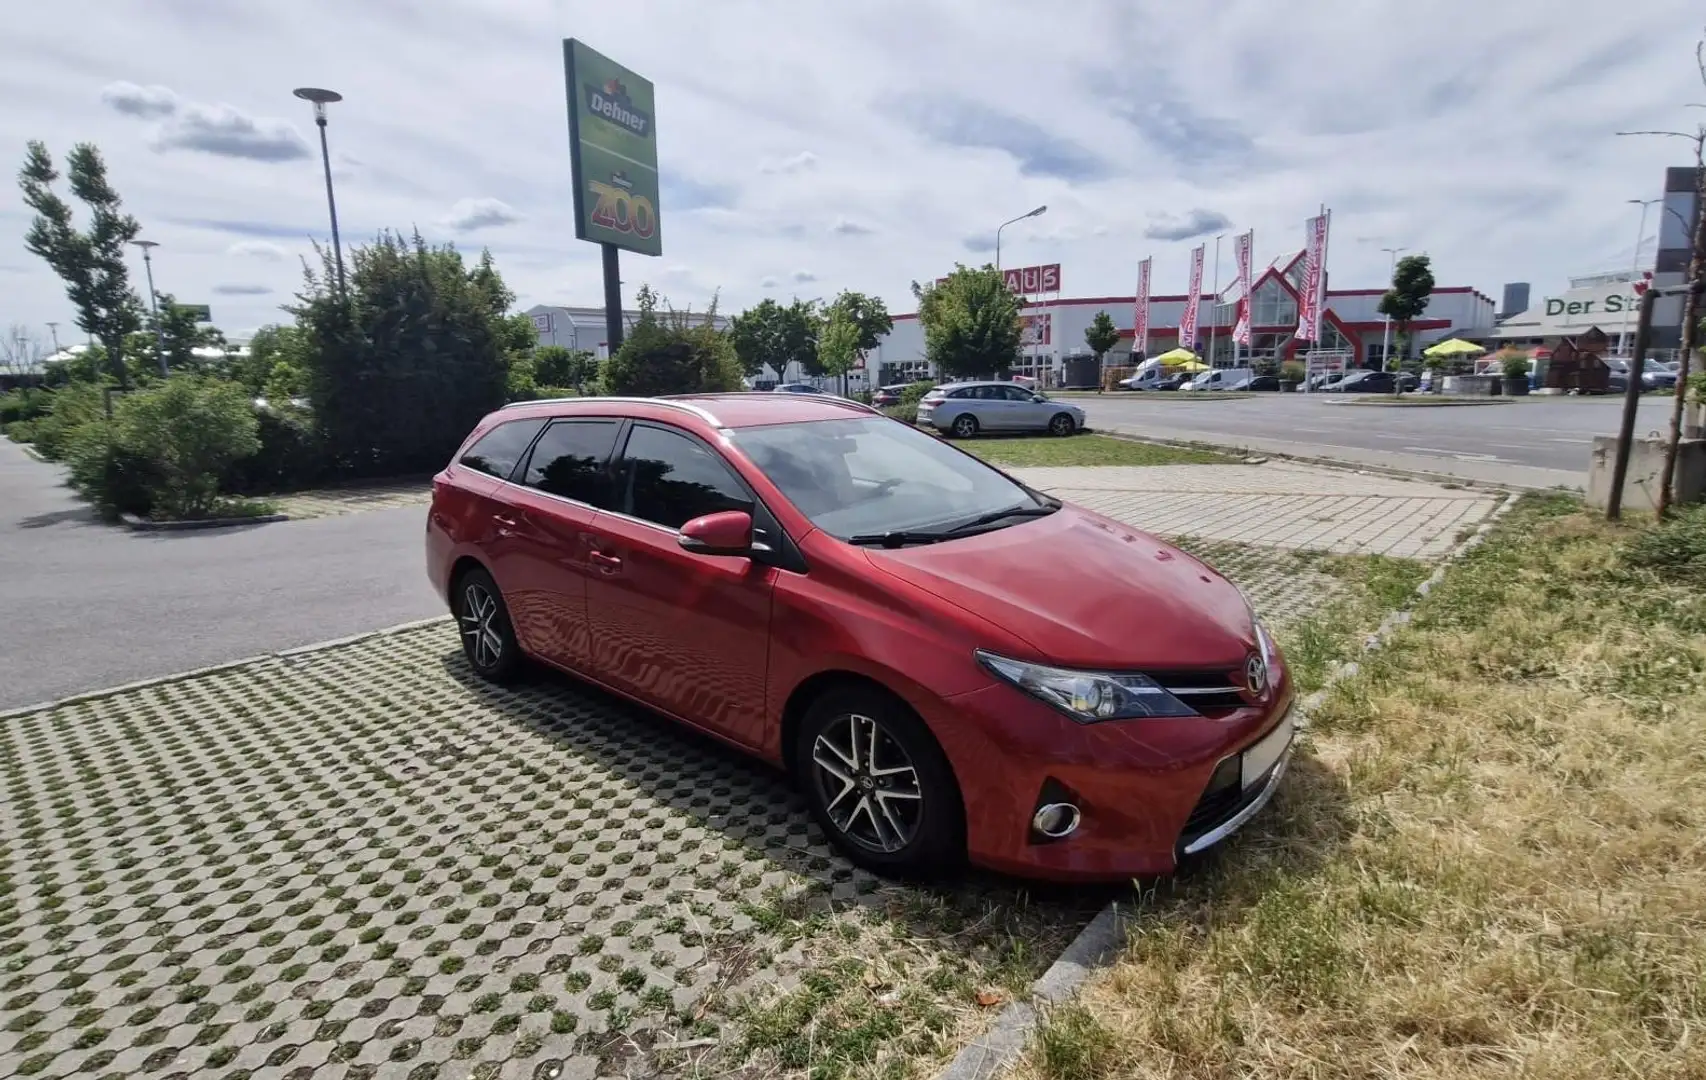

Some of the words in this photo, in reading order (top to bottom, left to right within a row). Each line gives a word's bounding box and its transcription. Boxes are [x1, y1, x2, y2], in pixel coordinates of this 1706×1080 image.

[591, 93, 647, 131] Dehner
[588, 180, 655, 239] ZOO
[1006, 268, 1057, 290] AUS
[1546, 297, 1595, 316] Der
